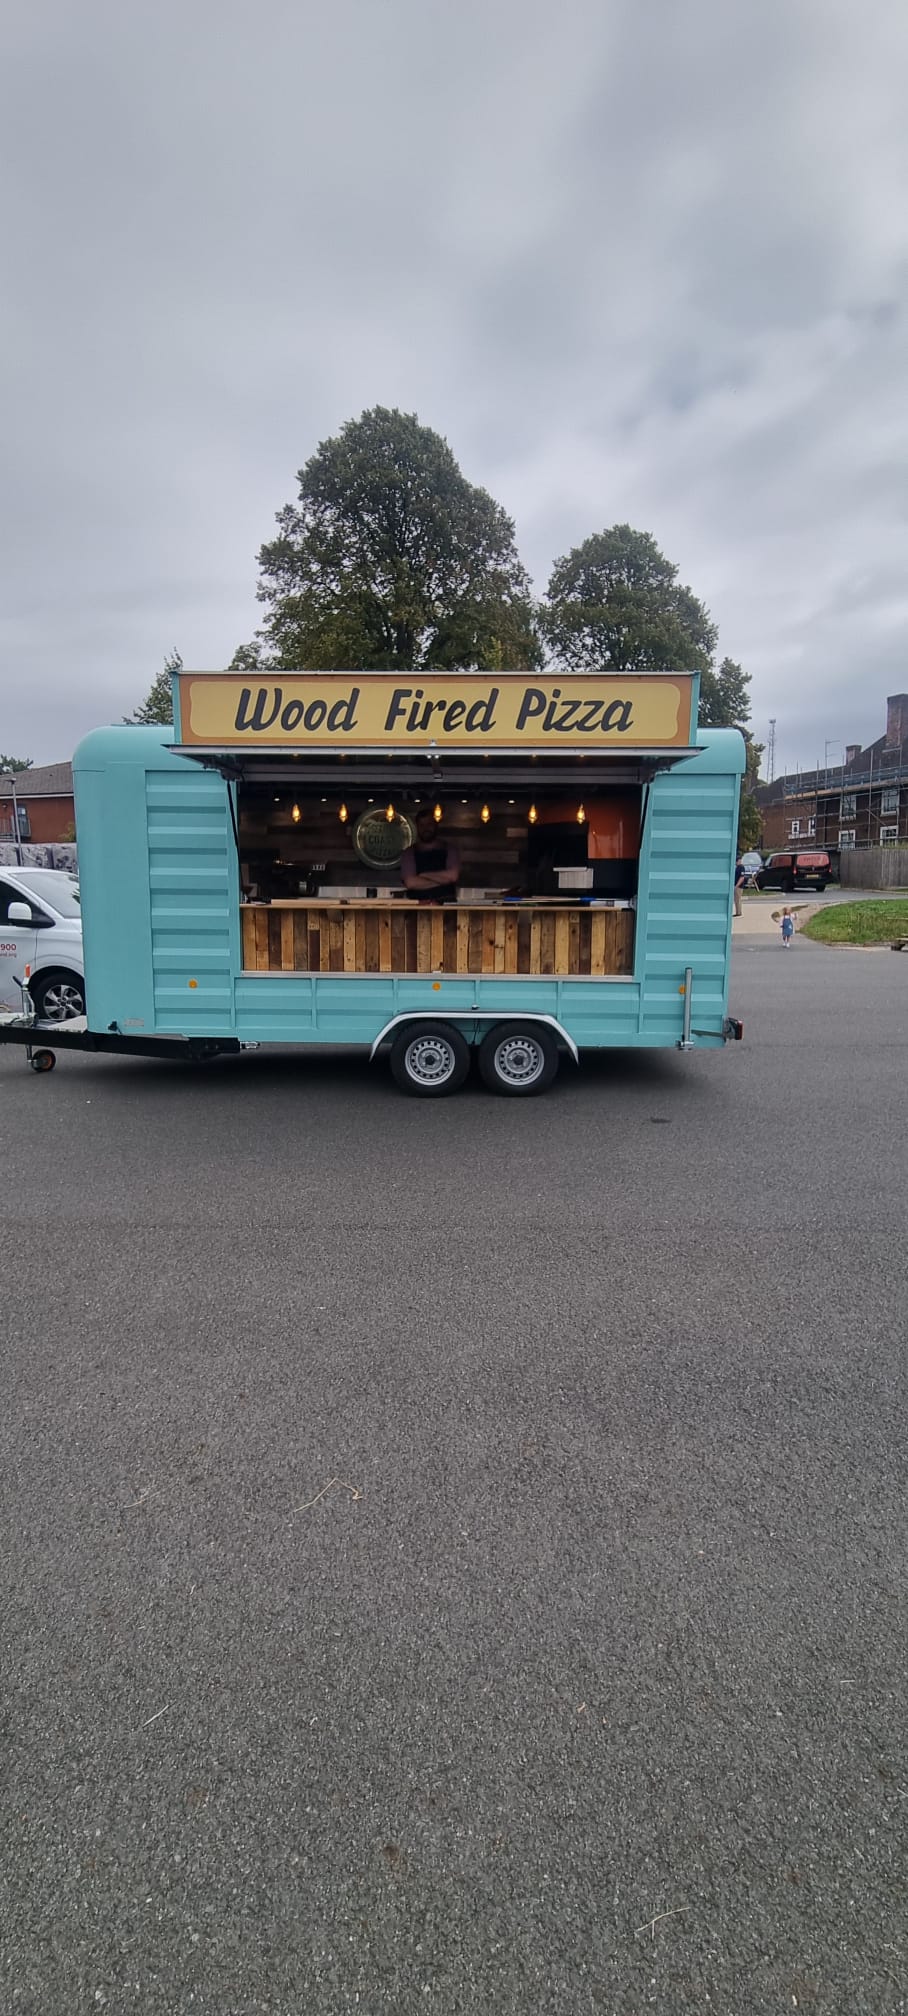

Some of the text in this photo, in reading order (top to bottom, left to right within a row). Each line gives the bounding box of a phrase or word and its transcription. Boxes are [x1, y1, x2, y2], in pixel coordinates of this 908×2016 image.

[234, 687, 633, 731] Wood Fired Pizza
